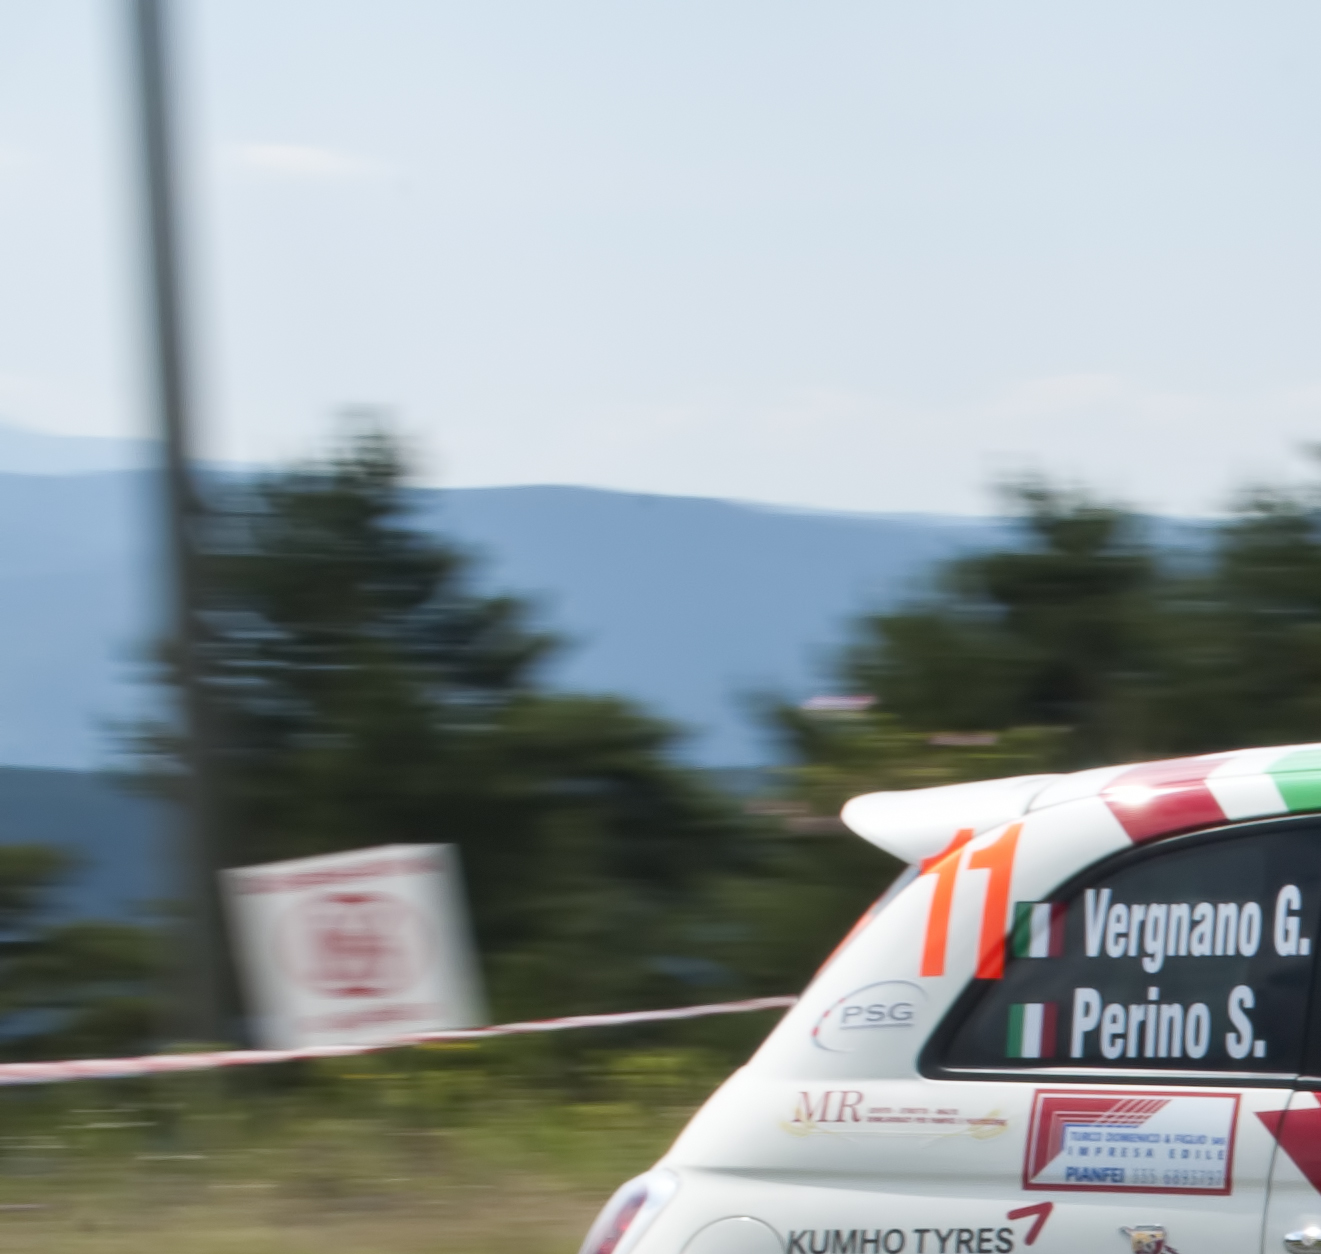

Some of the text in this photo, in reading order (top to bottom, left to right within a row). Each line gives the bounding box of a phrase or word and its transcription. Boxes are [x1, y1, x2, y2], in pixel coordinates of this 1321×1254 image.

[919, 823, 1024, 979] 11
[1084, 884, 1311, 974] Vergnano G.
[841, 1002, 914, 1023] PSG
[1071, 984, 1267, 1060] Perino S.
[790, 1090, 865, 1123] MR
[1066, 1146, 1225, 1160] IMPRESA EDILE
[913, 1226, 1016, 1254] TYRES
